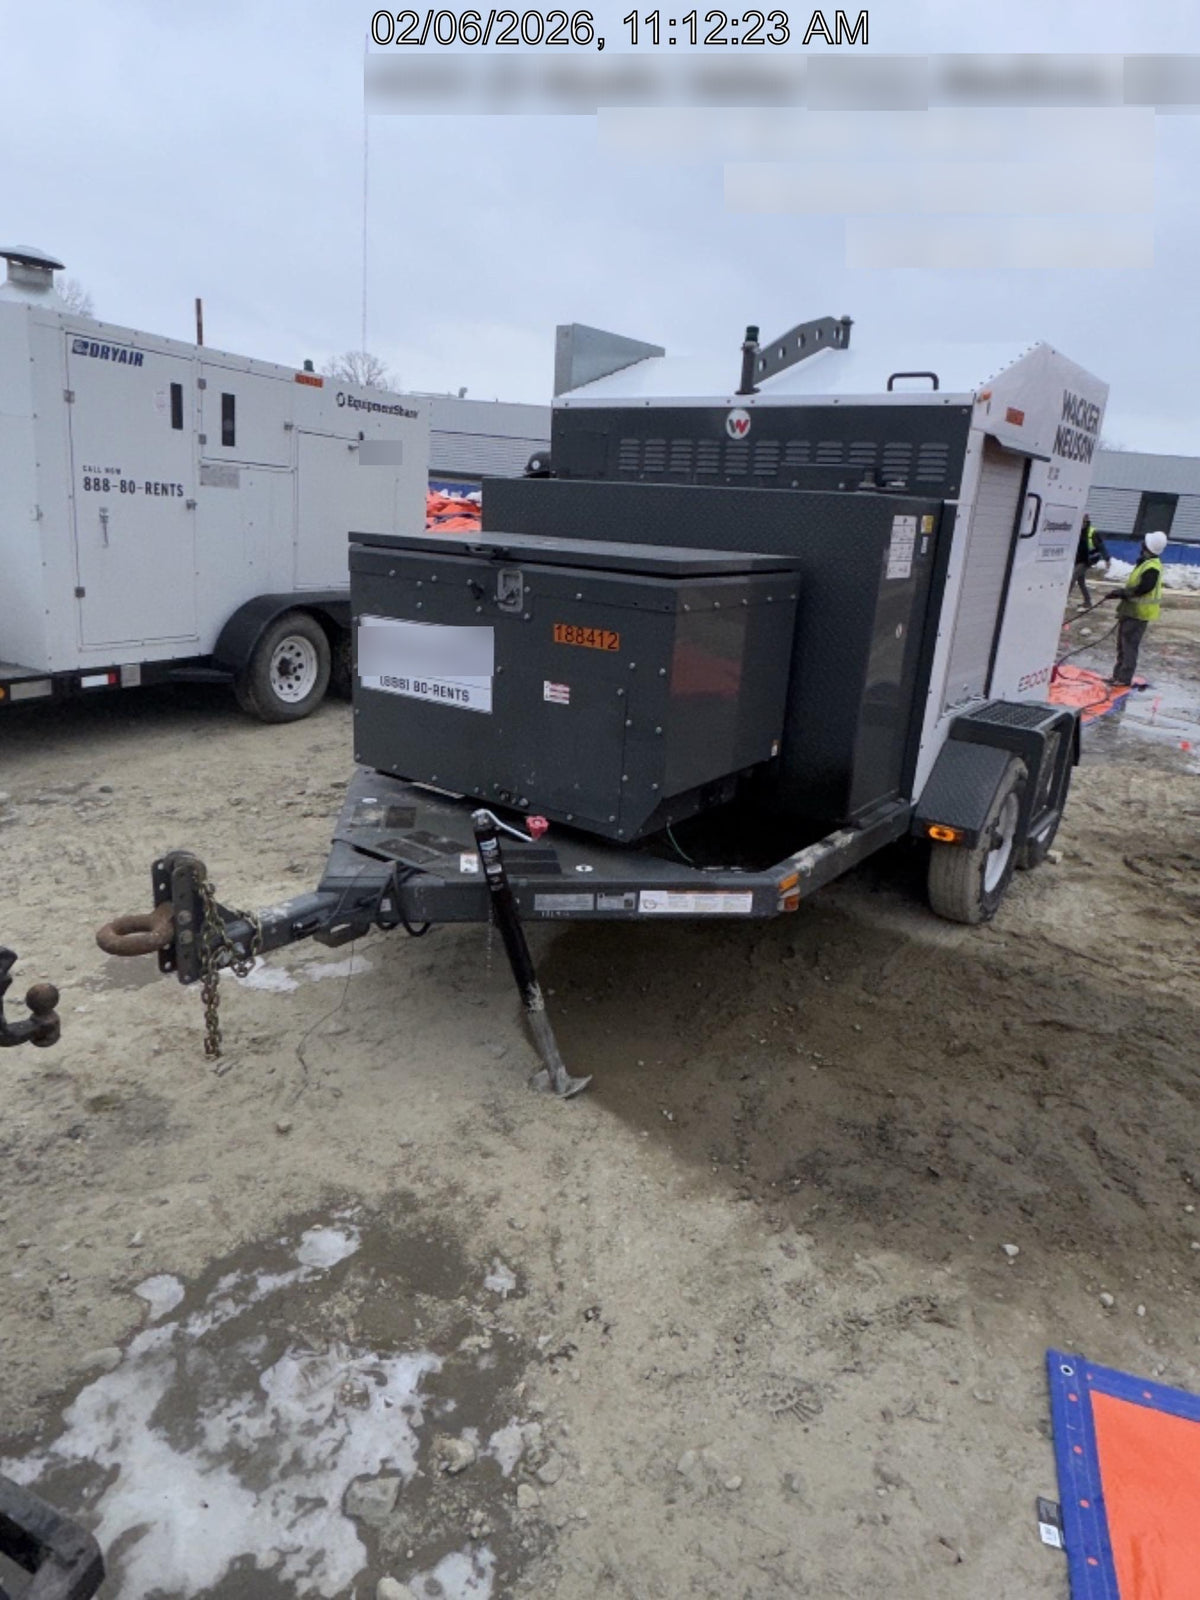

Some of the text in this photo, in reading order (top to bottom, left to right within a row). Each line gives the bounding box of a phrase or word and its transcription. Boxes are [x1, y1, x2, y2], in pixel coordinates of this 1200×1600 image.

[89, 342, 144, 367] DRYAIR
[1061, 388, 1100, 435] WACKER
[1052, 424, 1096, 465] NEUSON
[84, 476, 184, 497] 888-80-RENTS
[556, 625, 618, 650] 188412
[413, 680, 470, 702] 80-RENTS
